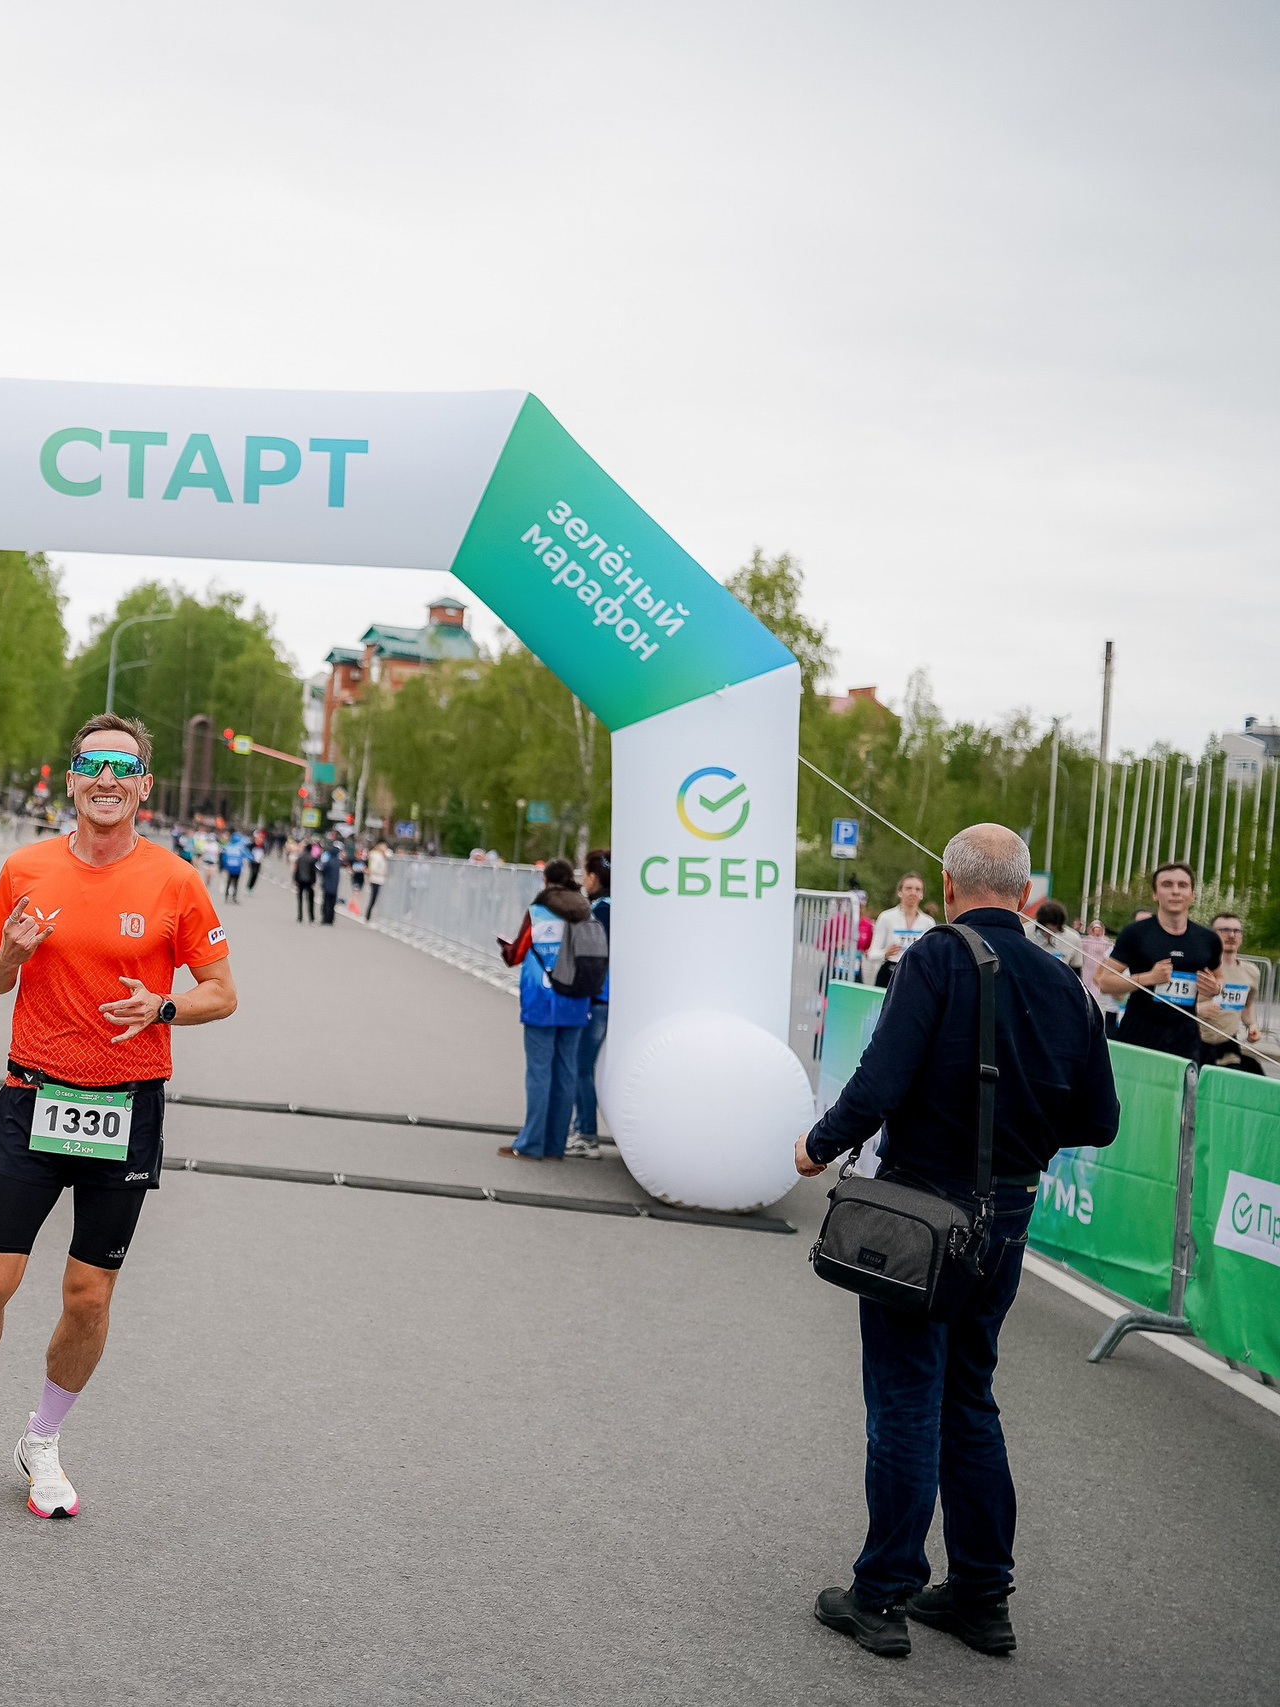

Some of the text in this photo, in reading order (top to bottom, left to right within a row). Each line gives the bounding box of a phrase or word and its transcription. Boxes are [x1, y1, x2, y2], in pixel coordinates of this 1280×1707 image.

[39, 427, 369, 508] СТАРТ
[546, 500, 691, 638] зелёный
[520, 523, 660, 662] марафон
[839, 822, 854, 845] P
[640, 856, 779, 899] СБЕР
[119, 912, 145, 938] 10
[1166, 981, 1190, 995] 715
[45, 1105, 121, 1138] 1330
[1040, 1172, 1094, 1225] тме
